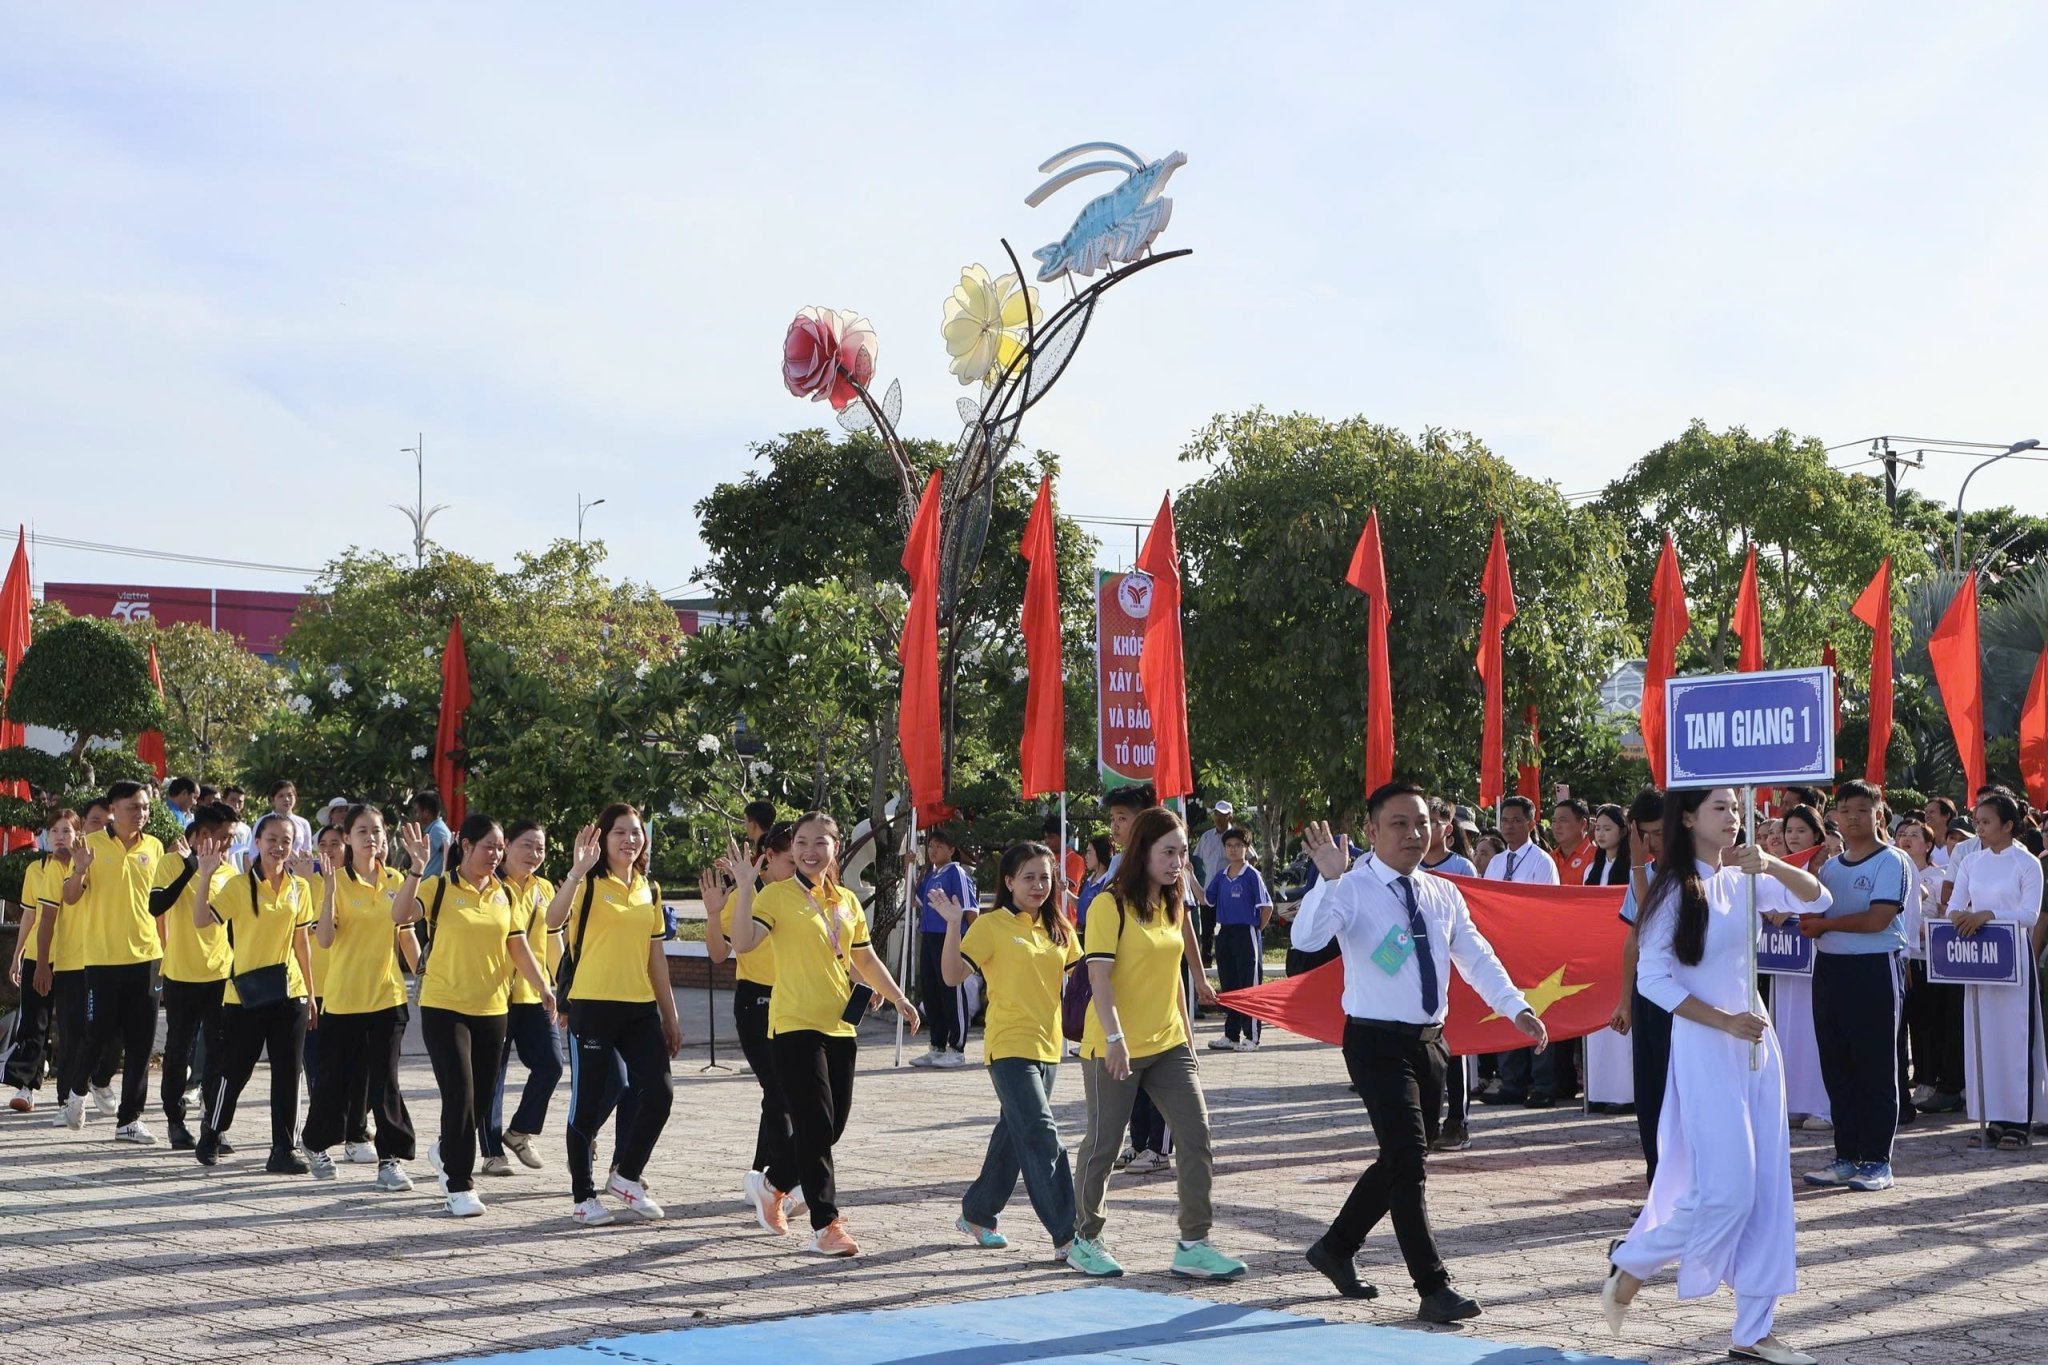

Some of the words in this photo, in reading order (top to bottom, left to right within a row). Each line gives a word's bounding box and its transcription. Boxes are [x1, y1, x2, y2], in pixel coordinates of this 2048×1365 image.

[111, 601, 151, 625] 5G
[1113, 629, 1144, 657] KHỎE
[1109, 667, 1132, 692] XÂY
[1109, 703, 1125, 728] VÀ
[1127, 701, 1151, 730] BẢO
[1684, 711, 1725, 750] TAM
[1731, 706, 1794, 748] GIANG
[1801, 706, 1810, 743] 1
[1114, 735, 1129, 765] TỔ
[1132, 738, 1156, 767] QUỐ
[1770, 929, 1793, 956] CĂN
[1795, 935, 1801, 956] 1
[1946, 935, 1979, 964] CÔNG
[1981, 941, 1999, 964] AN
